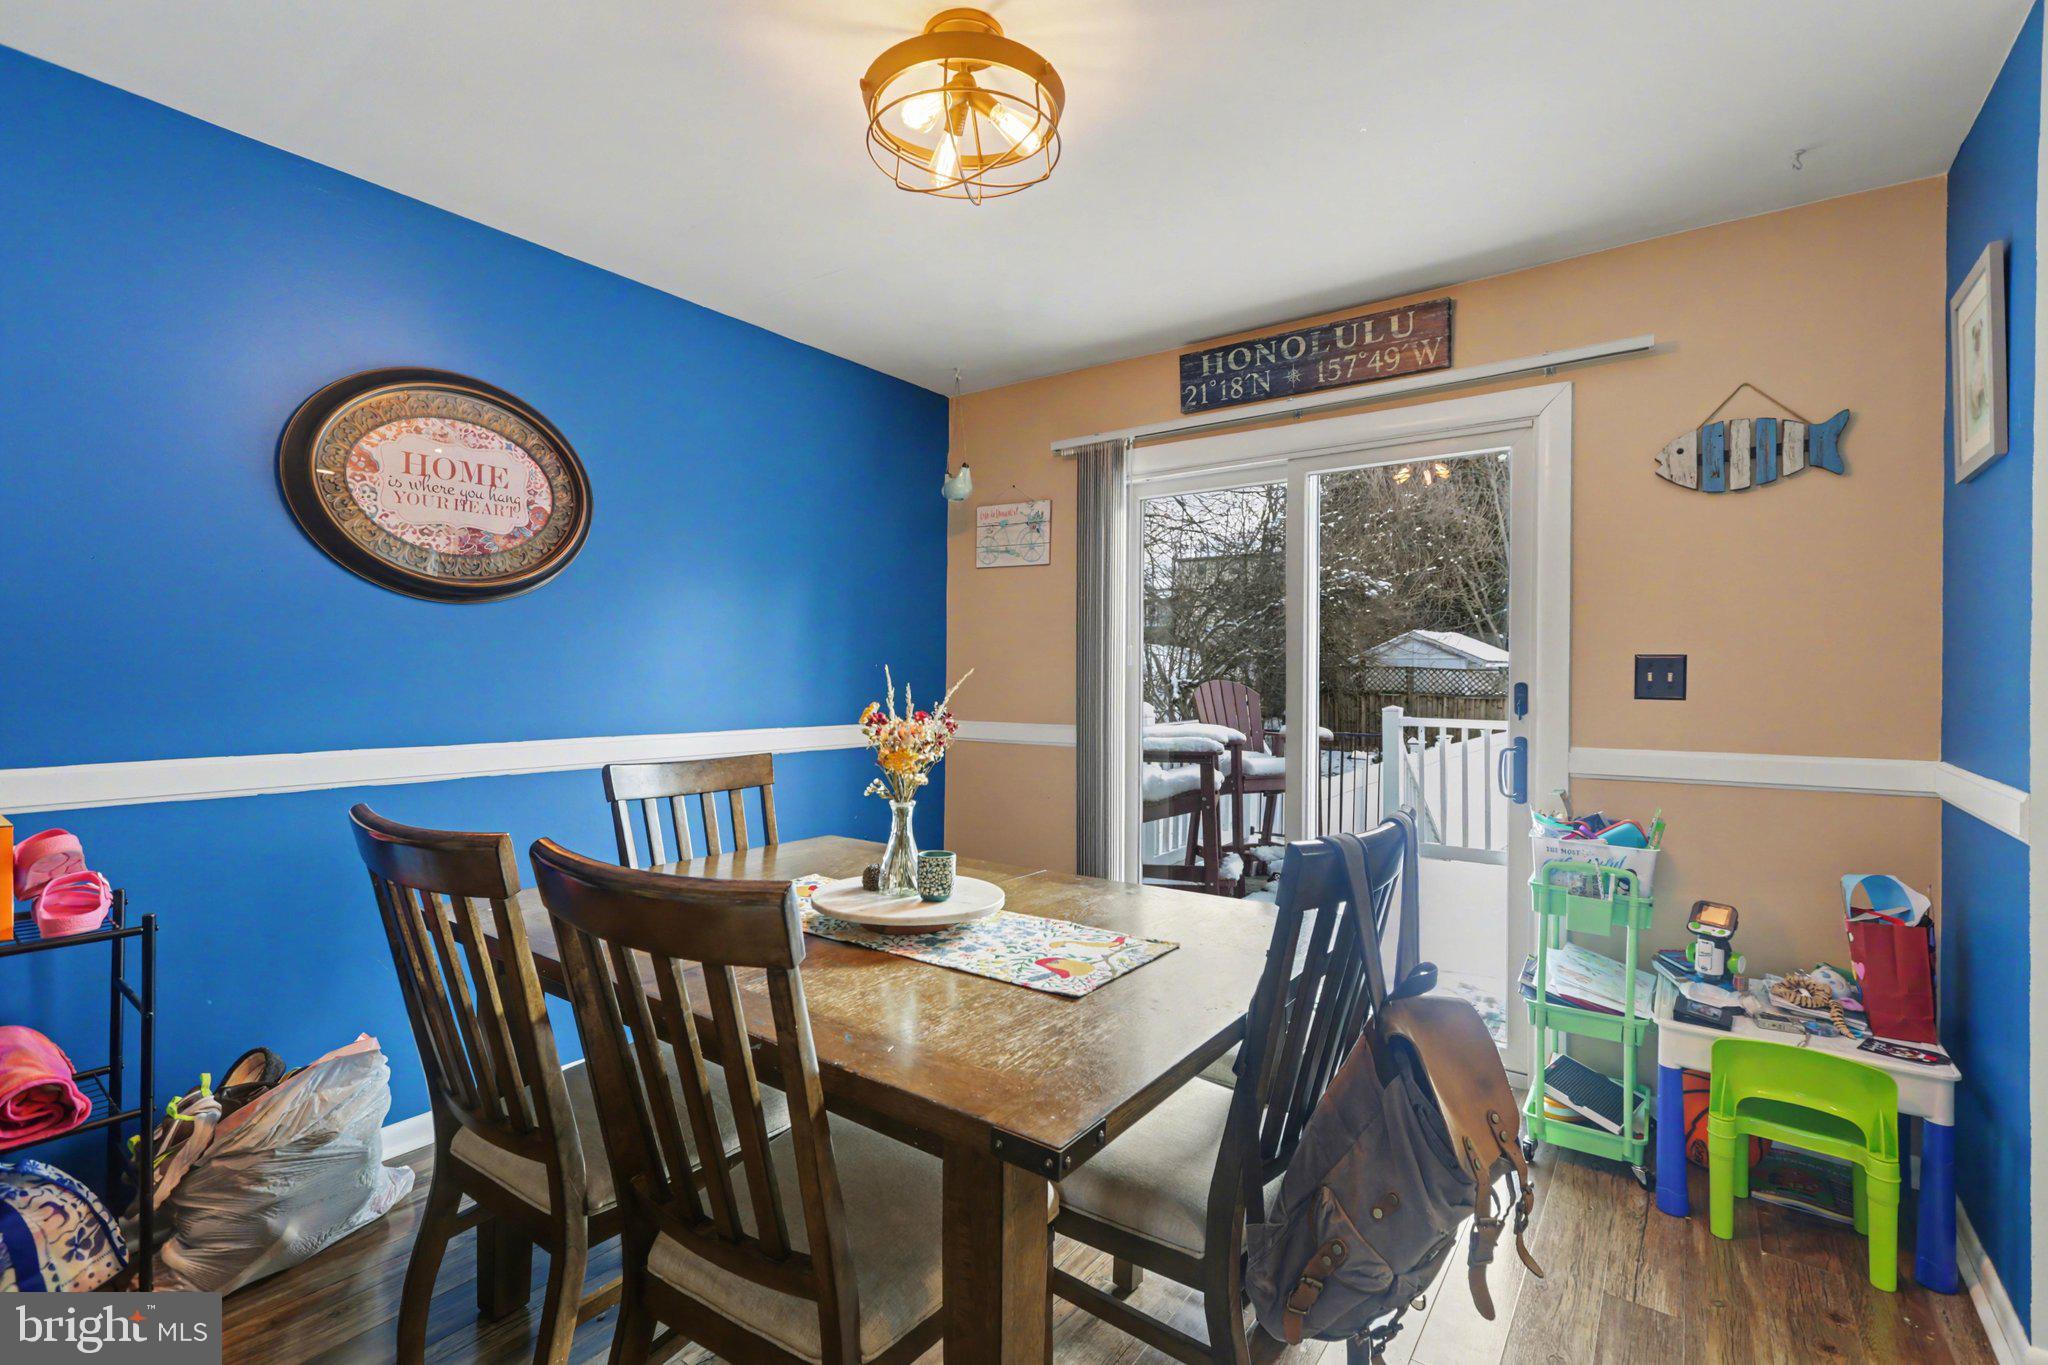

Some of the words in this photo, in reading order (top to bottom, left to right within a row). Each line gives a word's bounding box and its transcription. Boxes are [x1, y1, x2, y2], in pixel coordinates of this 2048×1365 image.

[1201, 310, 1415, 378] HONOLULU
[401, 450, 510, 490] HOME
[388, 474, 403, 488] is
[408, 474, 455, 496] where
[460, 487, 484, 507] you
[488, 485, 521, 513] hang
[394, 489, 449, 510] YOUR
